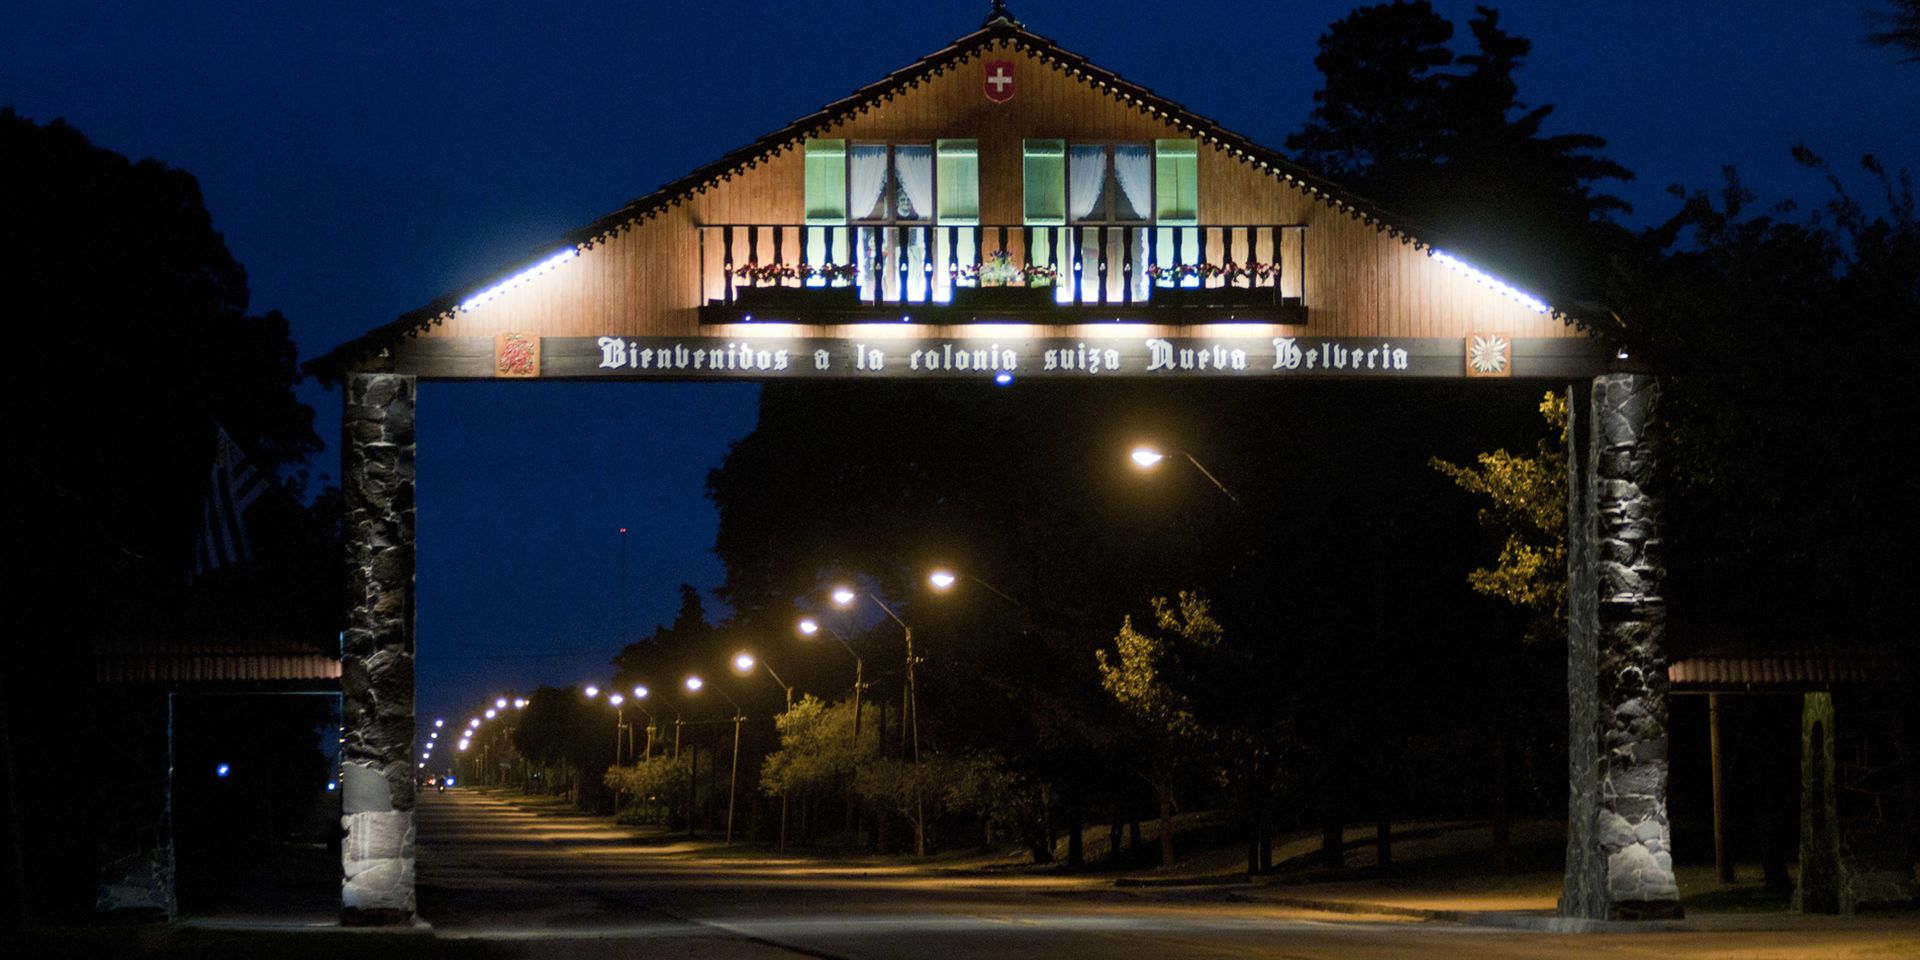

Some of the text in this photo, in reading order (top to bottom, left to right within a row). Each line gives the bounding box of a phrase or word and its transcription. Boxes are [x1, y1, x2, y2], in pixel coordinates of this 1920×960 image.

[598, 337, 1409, 373] Bienvenidos a la colonia suiza Nueva Helvecia
